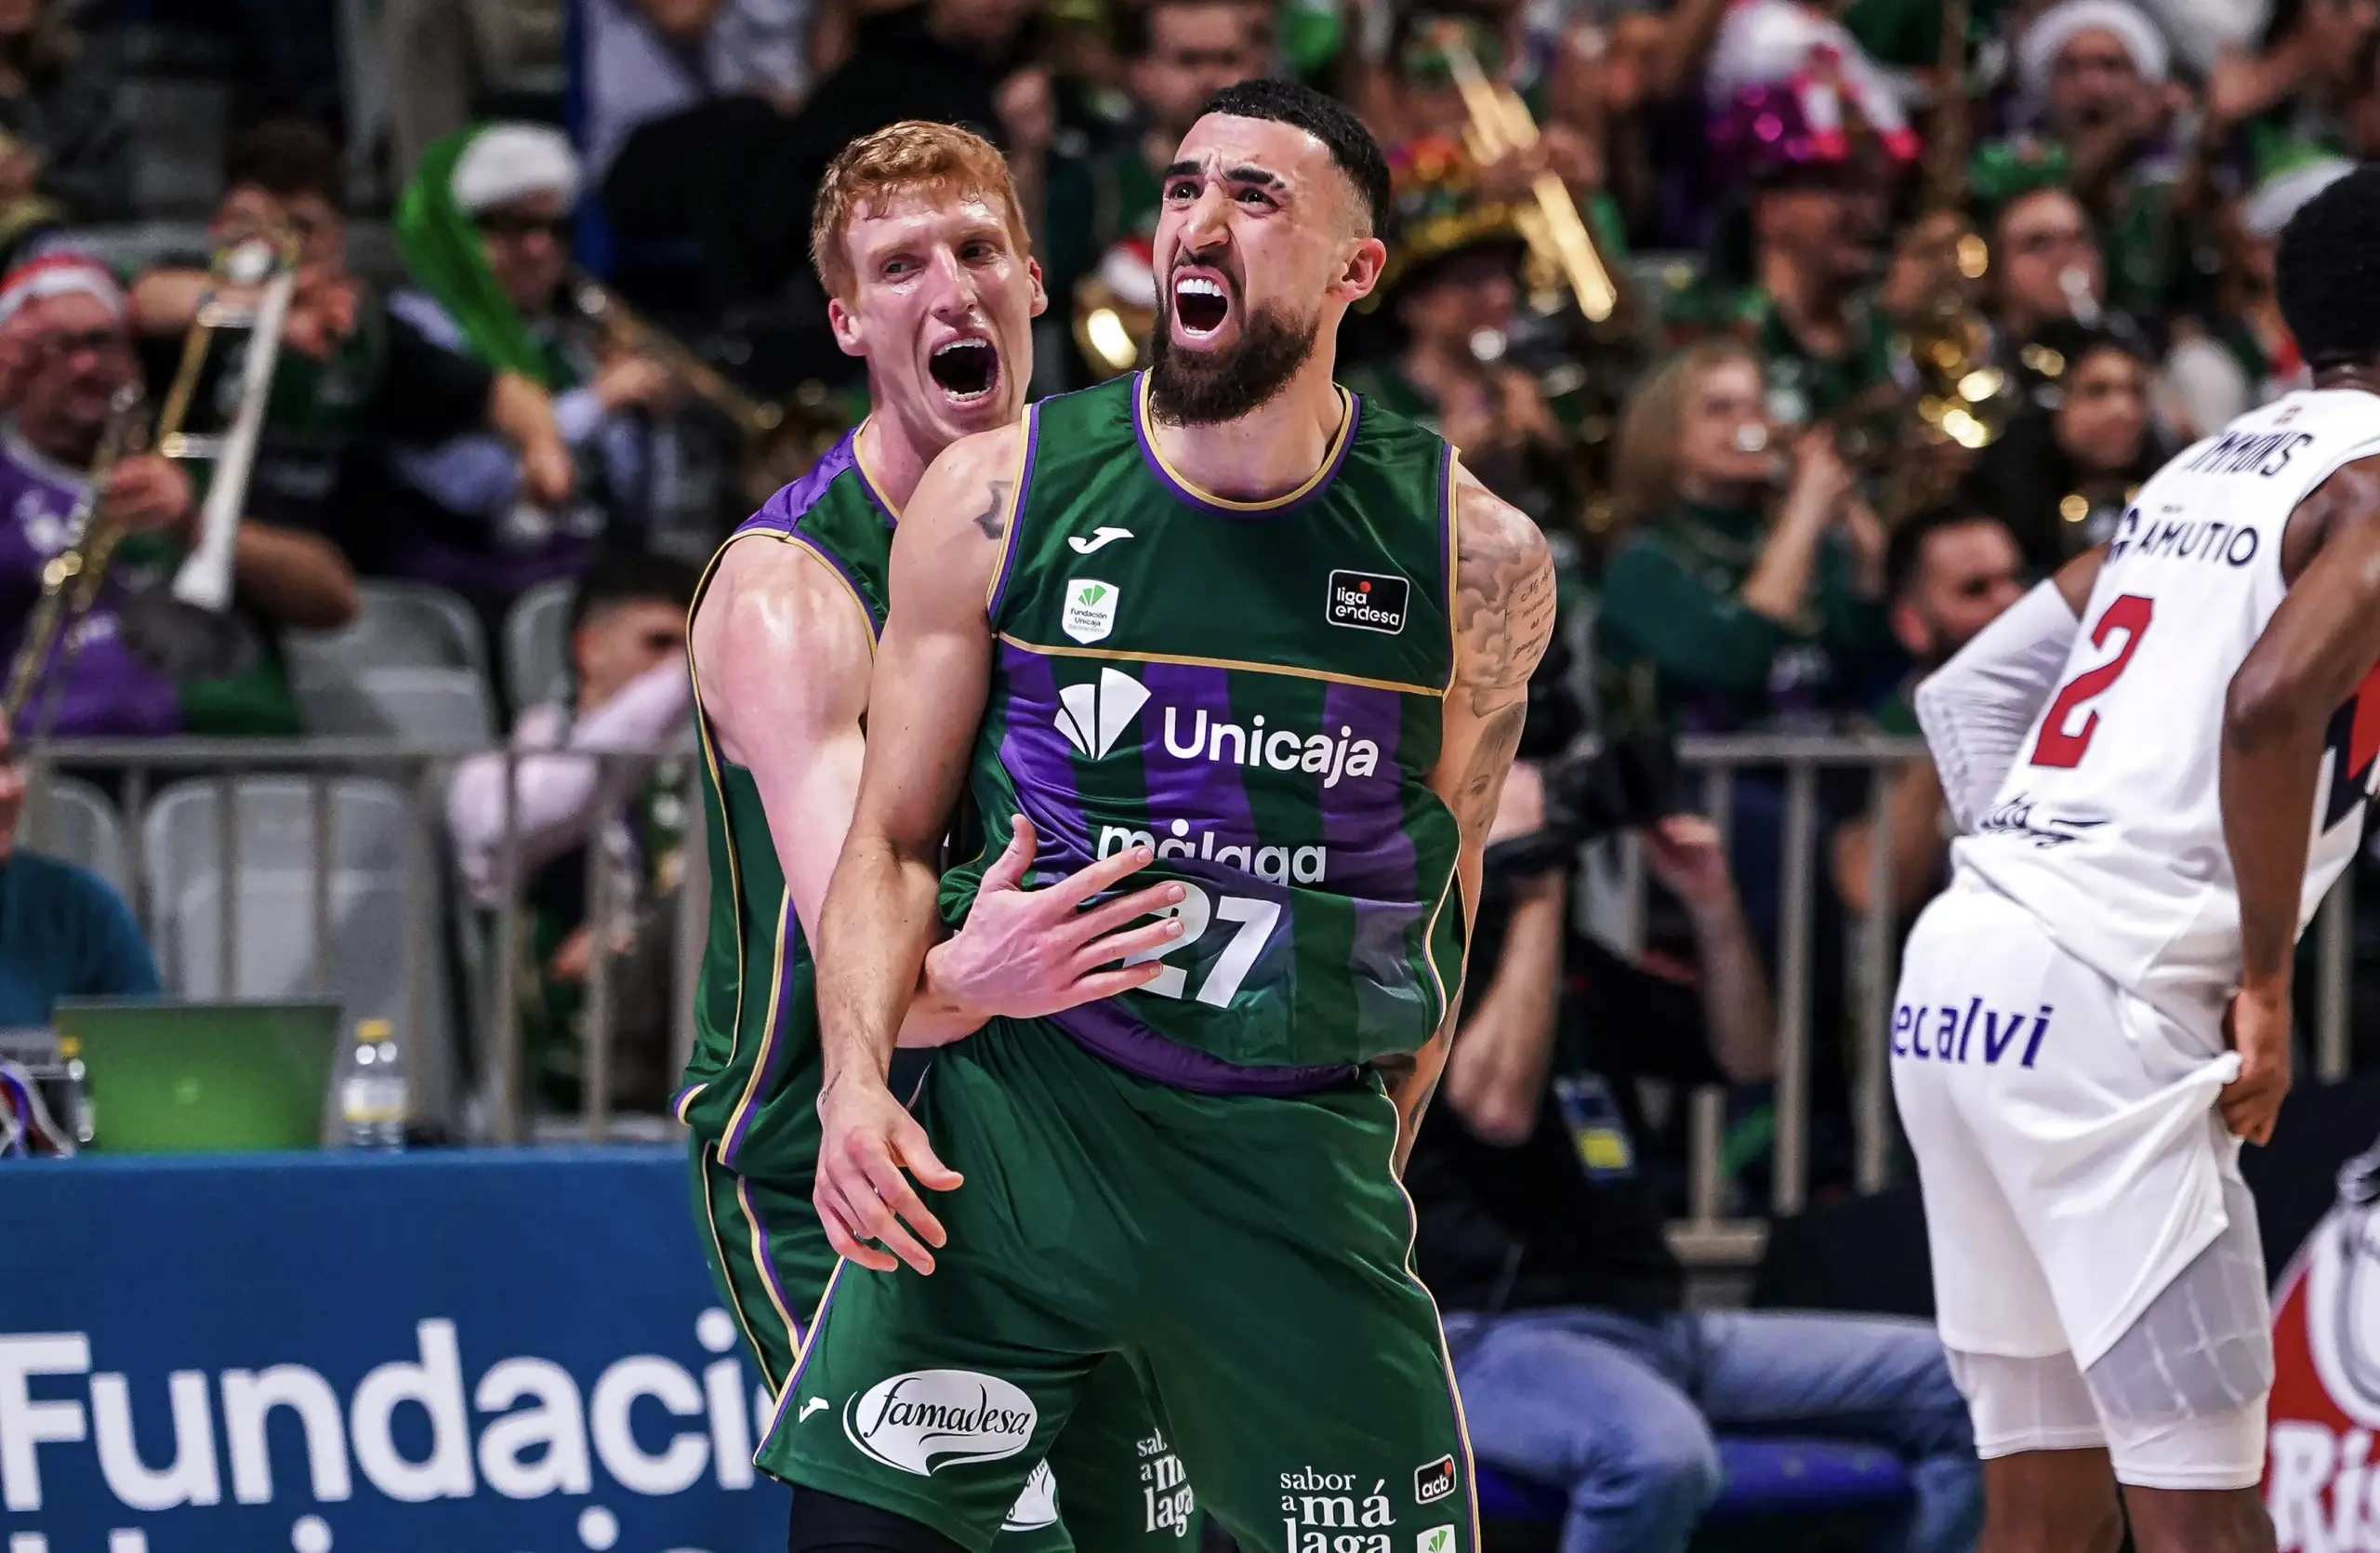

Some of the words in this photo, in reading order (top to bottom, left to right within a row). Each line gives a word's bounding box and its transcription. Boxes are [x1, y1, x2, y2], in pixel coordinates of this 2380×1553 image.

[1335, 604, 1400, 626] endesa
[1337, 587, 1367, 605] liga
[1074, 617, 1101, 628] Unicaja
[2030, 594, 2154, 769] 2
[1164, 706, 1379, 789] Unicaja
[1121, 880, 1282, 1009] 27
[0, 1307, 777, 1513] Fundaci
[863, 1377, 1031, 1439] famadesa
[1140, 1463, 1154, 1481] a
[1280, 1466, 1356, 1491] sabor
[1421, 1473, 1450, 1499] acb
[2267, 1419, 2380, 1553] Ri
[1281, 1495, 1298, 1512] a
[1299, 1479, 1396, 1528] má
